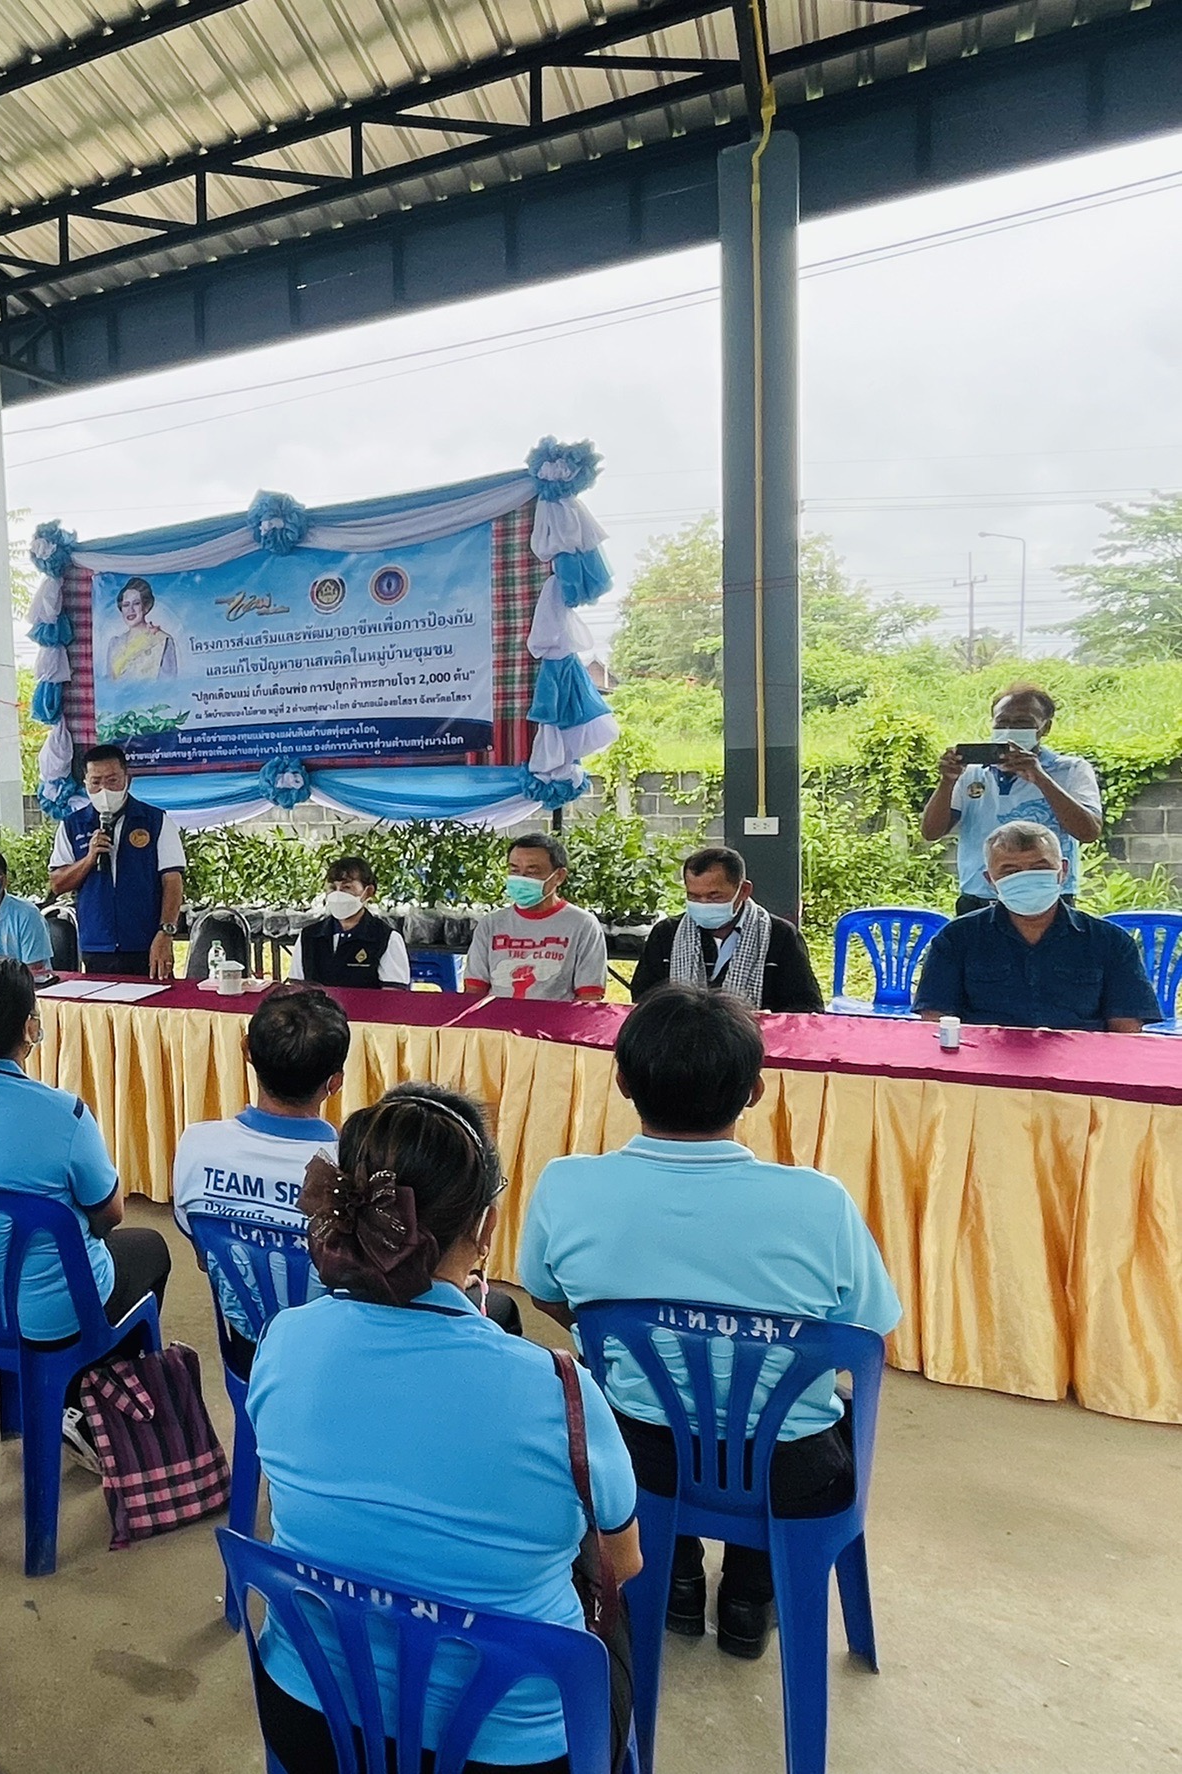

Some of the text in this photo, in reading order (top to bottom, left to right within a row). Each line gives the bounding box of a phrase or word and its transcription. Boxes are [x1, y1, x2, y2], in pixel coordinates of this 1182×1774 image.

[419, 671, 451, 685] 2,000
[509, 950, 564, 960] THE CLOUD
[204, 1167, 264, 1198] TEAM
